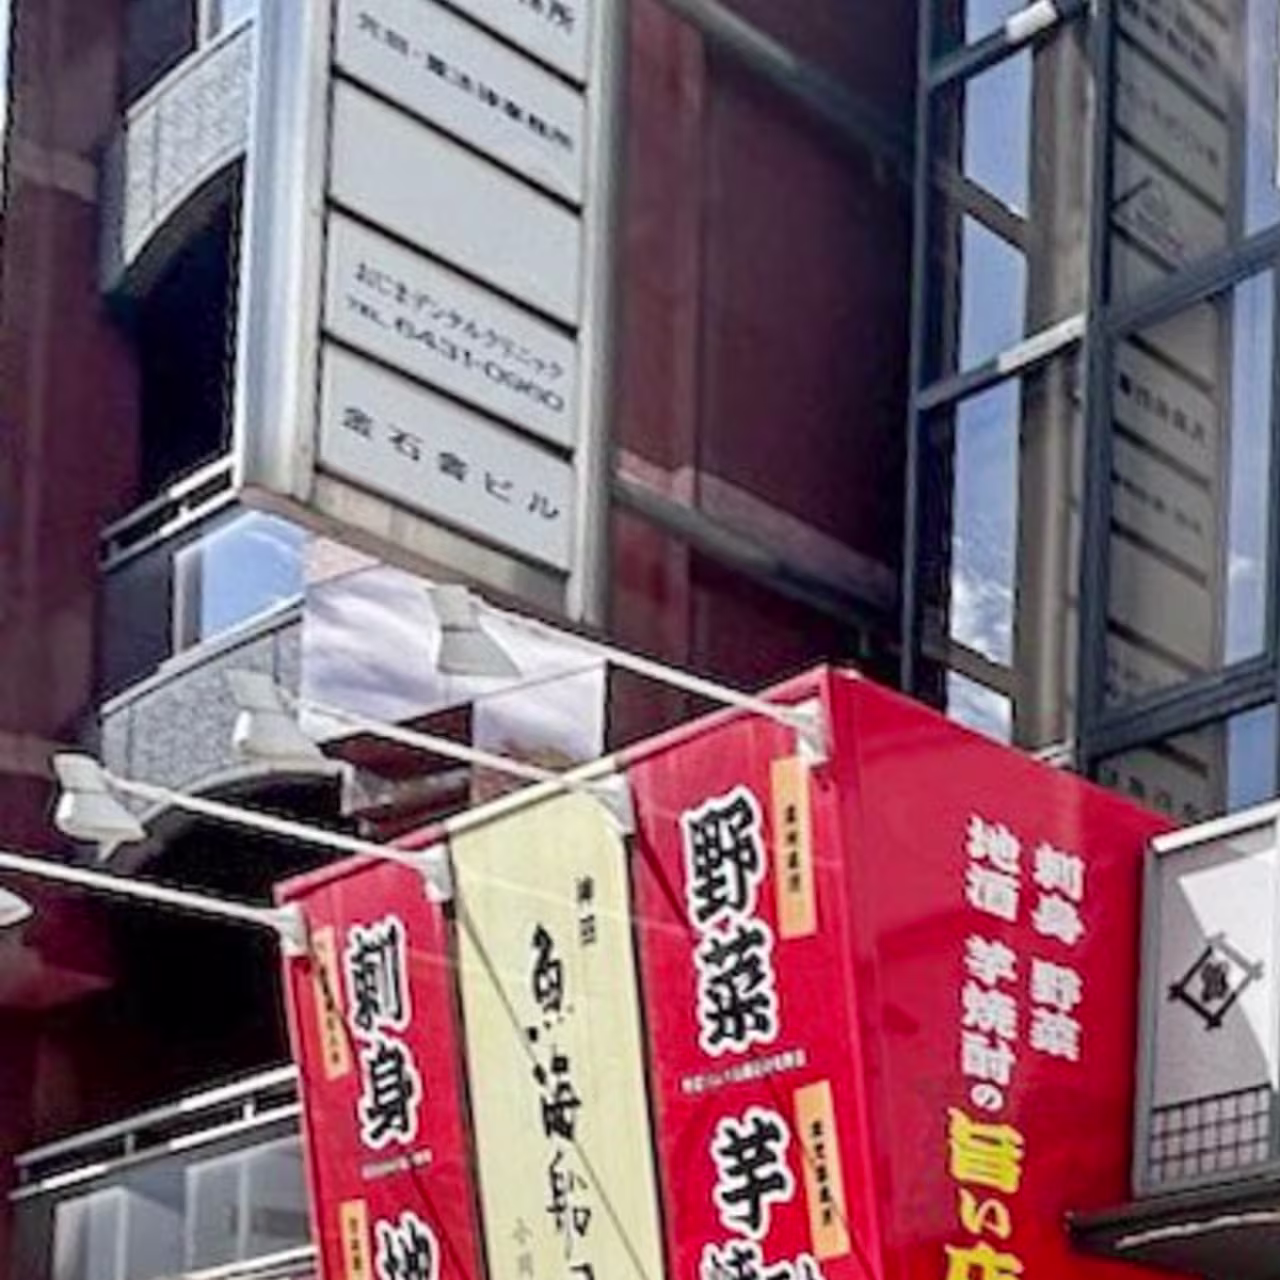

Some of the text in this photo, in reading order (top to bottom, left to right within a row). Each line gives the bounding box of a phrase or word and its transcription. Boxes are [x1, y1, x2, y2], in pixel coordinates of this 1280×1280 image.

[680, 785, 780, 1057] 野菜
[965, 812, 1021, 922] 地酒
[343, 915, 422, 1148] 刺身
[1030, 957, 1082, 1062] 野菜
